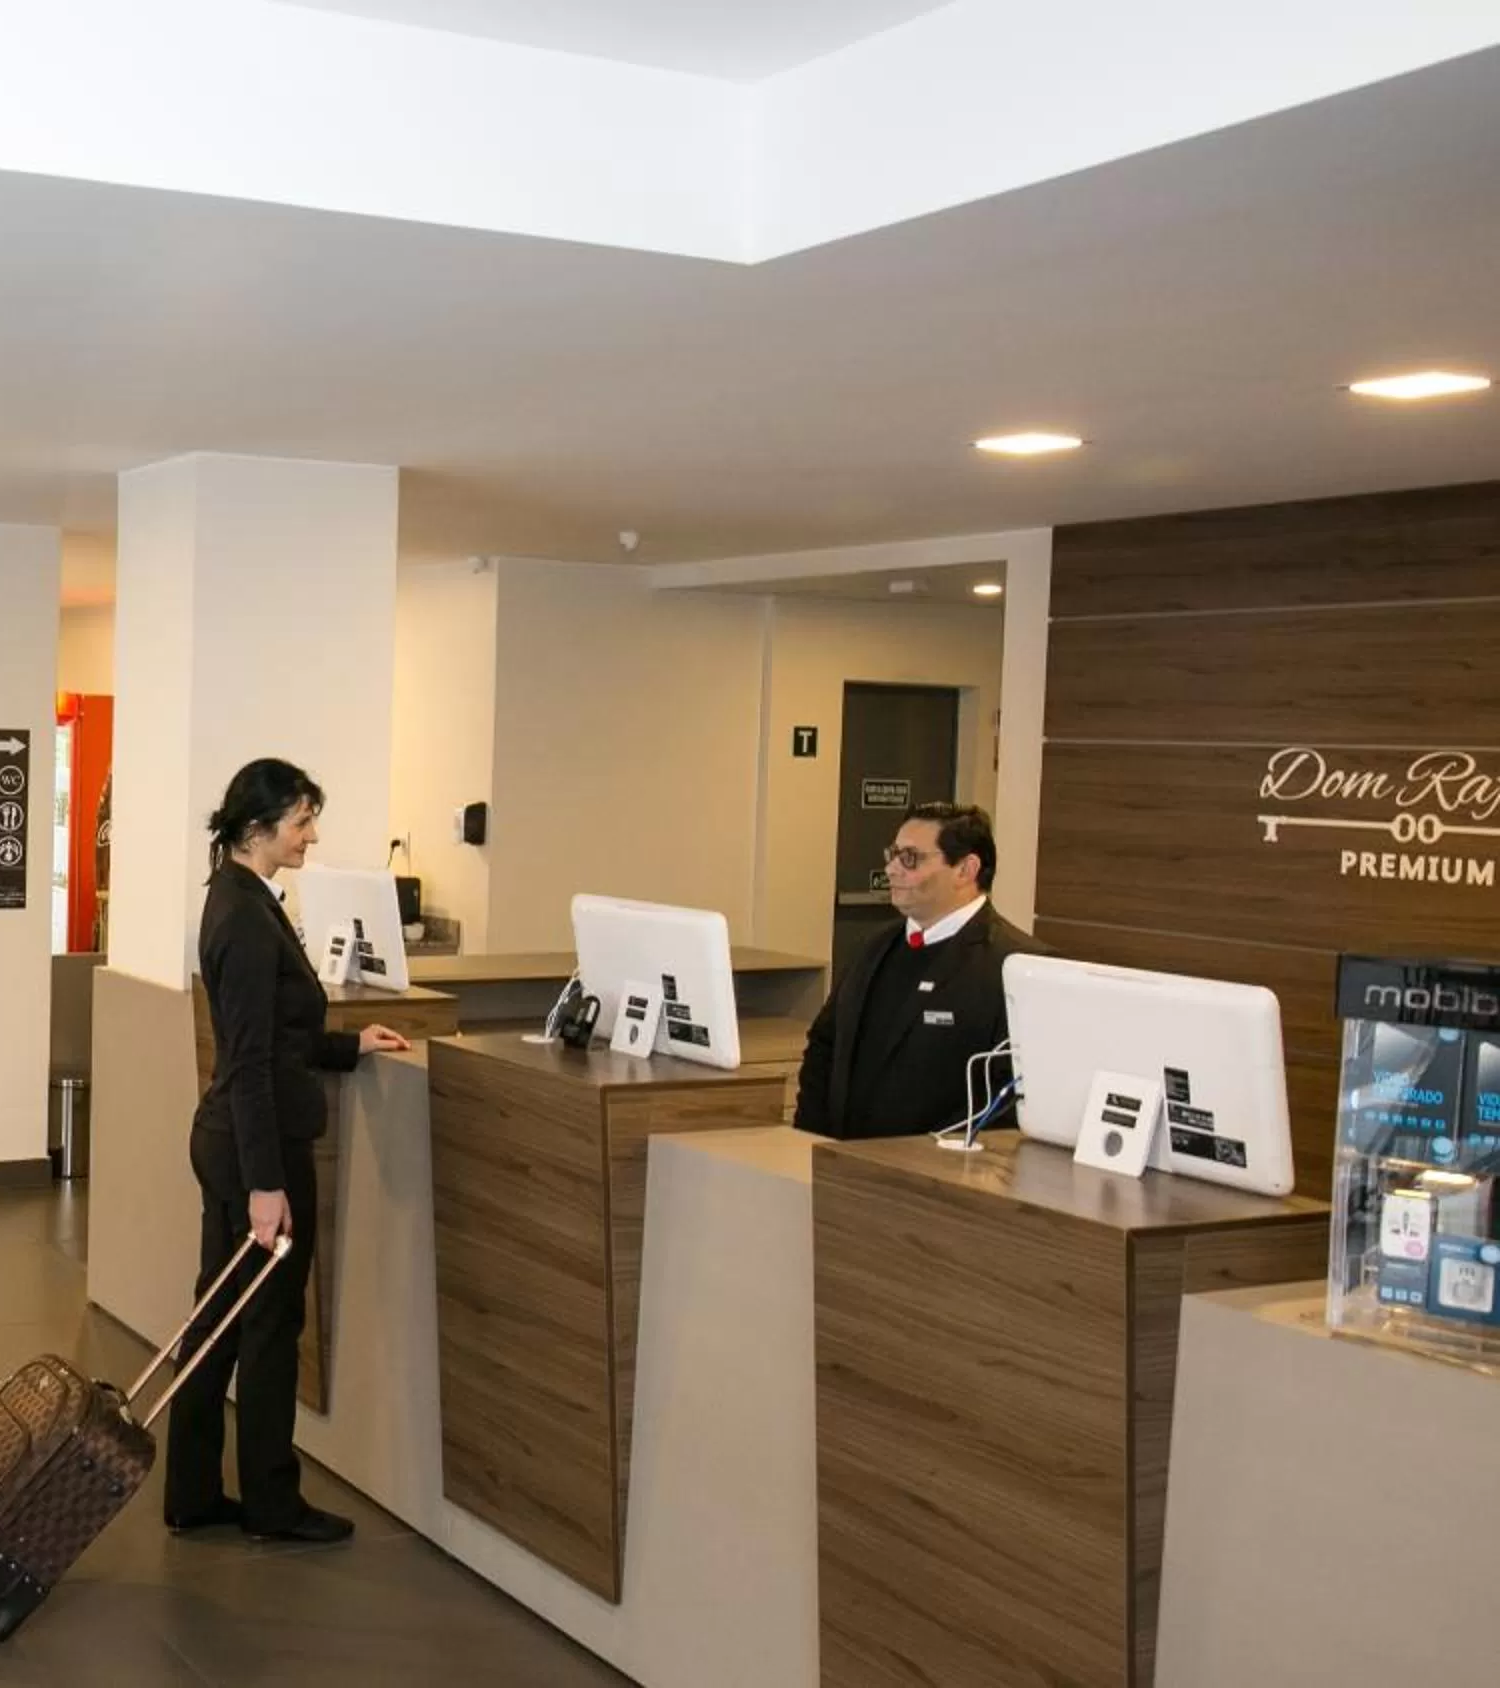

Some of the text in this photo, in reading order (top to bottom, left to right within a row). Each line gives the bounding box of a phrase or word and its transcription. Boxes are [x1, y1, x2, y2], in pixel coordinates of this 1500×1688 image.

[798, 730, 813, 753] T
[1, 775, 21, 786] WC
[1260, 747, 1394, 801] Dom
[1340, 850, 1495, 887] PREMIUM
